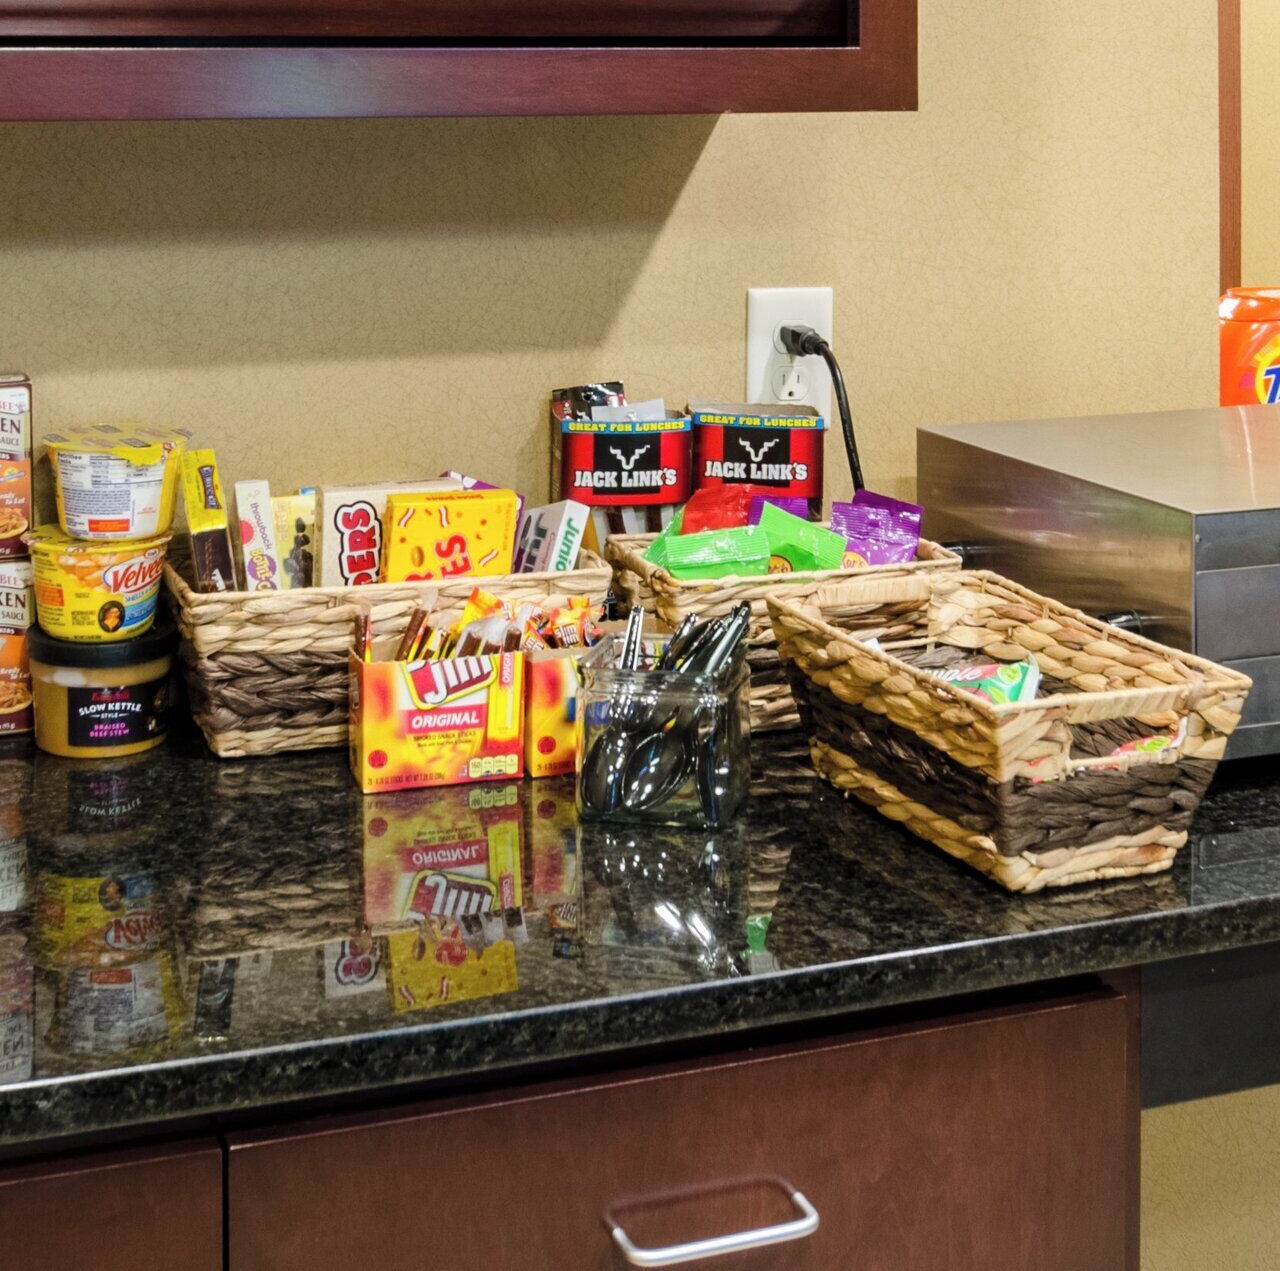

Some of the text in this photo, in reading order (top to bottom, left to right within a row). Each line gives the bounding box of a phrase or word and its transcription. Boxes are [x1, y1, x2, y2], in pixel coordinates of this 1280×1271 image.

[569, 421, 685, 432] GREAT FOR LUNCHES
[700, 414, 817, 427] GREAT FOR LUNCHES
[574, 468, 677, 488] JACK LINK'S
[705, 461, 808, 481] JACK LINK'S
[555, 516, 576, 572] Junio
[0, 575, 20, 585] BEE
[1, 611, 24, 621] SAUCE
[424, 658, 493, 705] Jim
[79, 702, 141, 716] SLOW KETTLE
[411, 712, 480, 730] ORIGINAL
